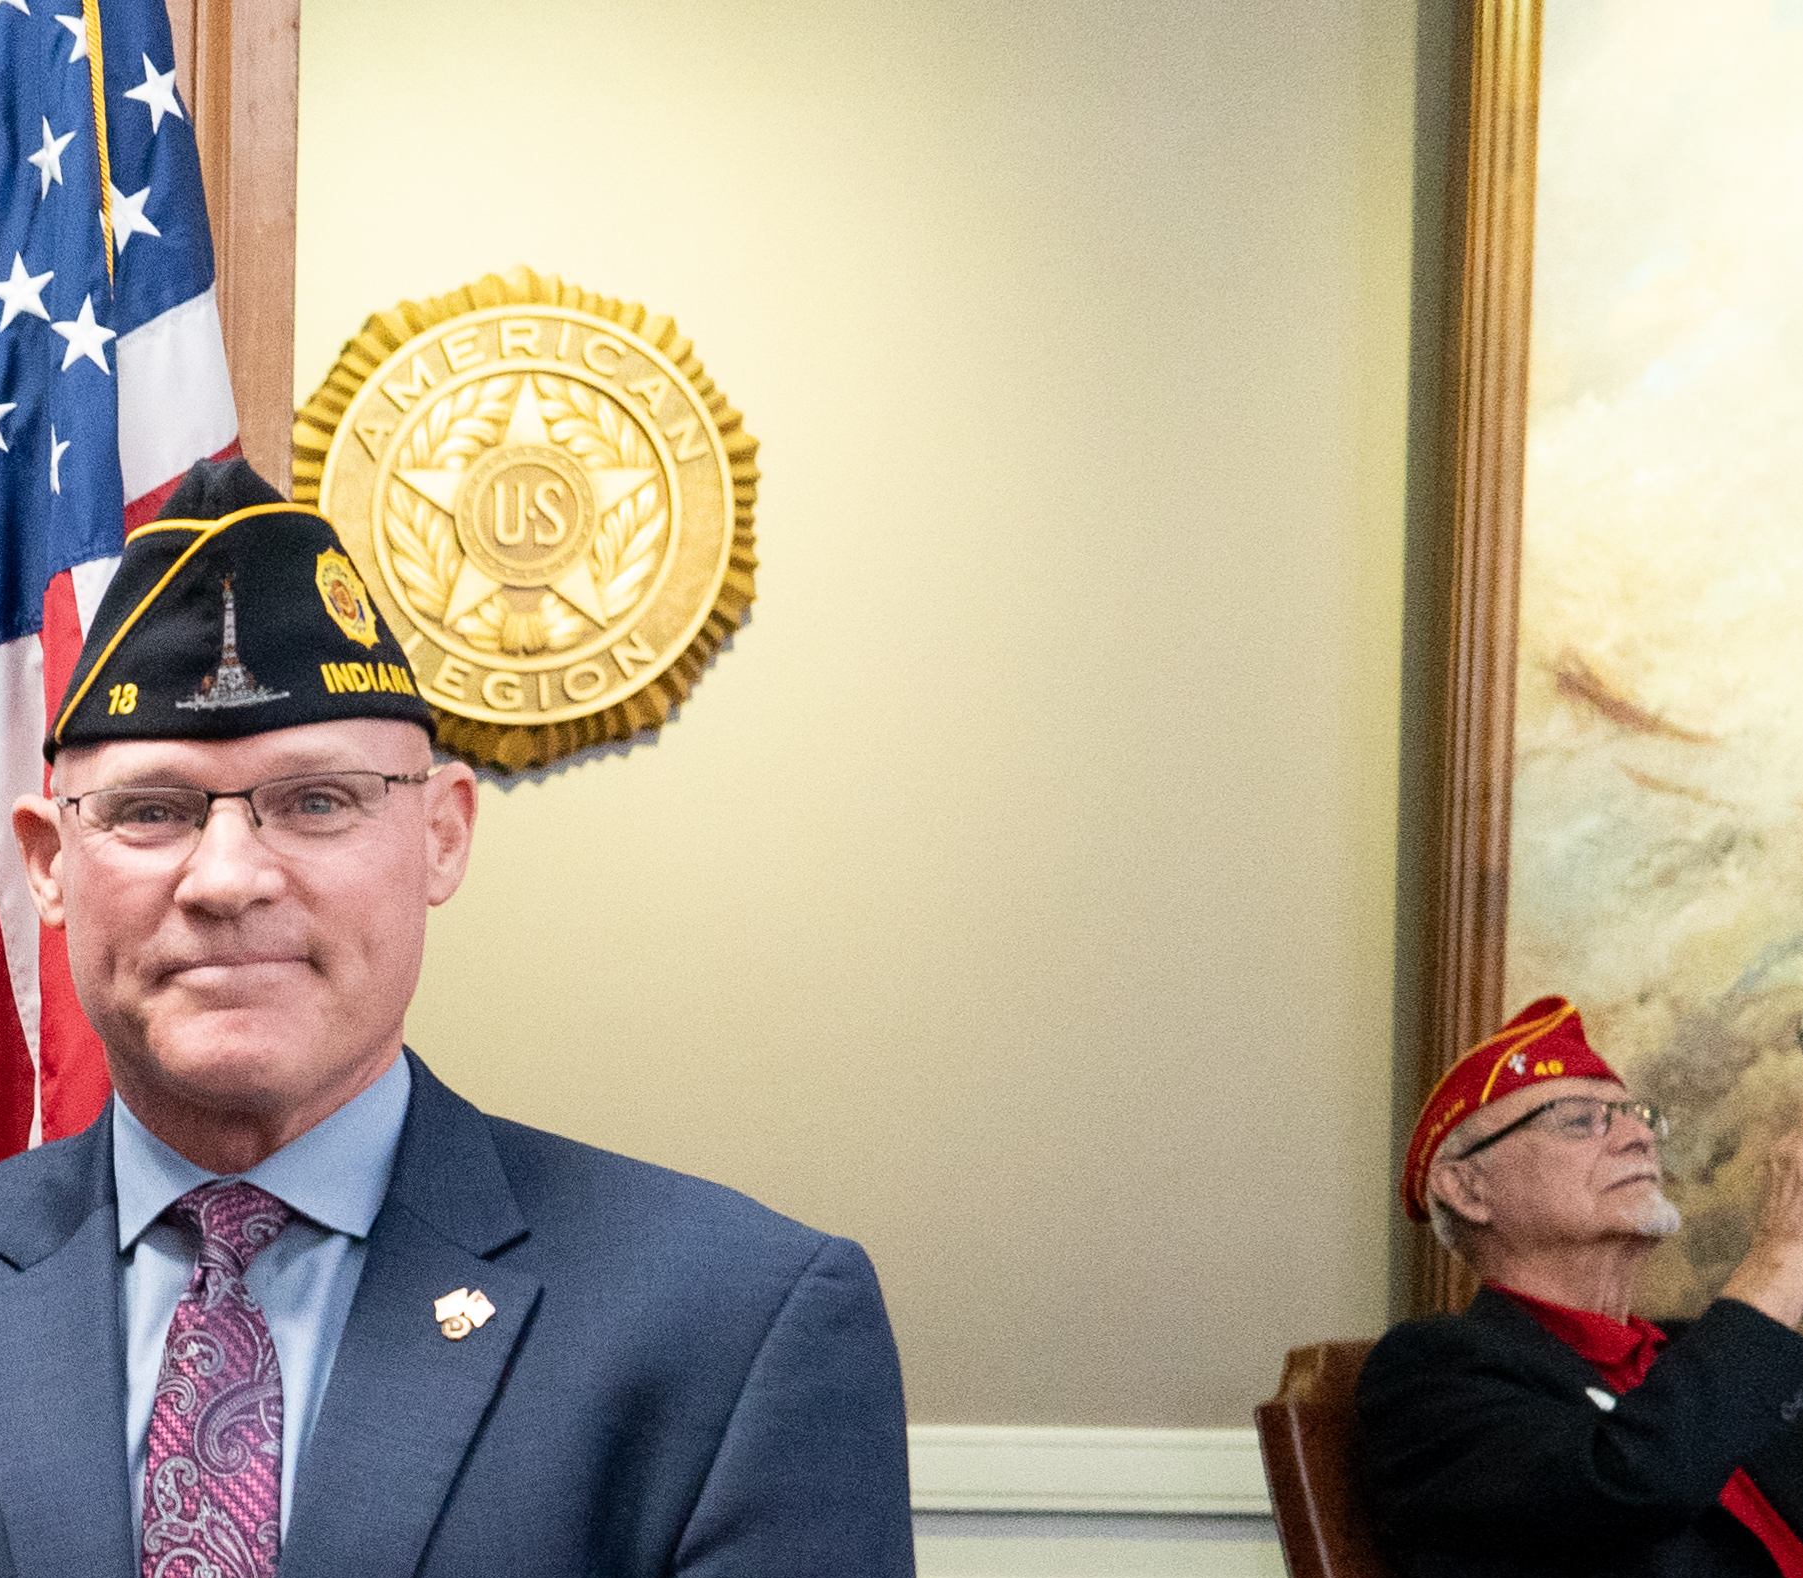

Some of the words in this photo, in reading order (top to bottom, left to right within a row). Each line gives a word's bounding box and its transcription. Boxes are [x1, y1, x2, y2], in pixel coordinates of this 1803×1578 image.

[353, 318, 709, 463] AMERICAN
[320, 662, 416, 696] INDIAN
[108, 683, 139, 716] 18
